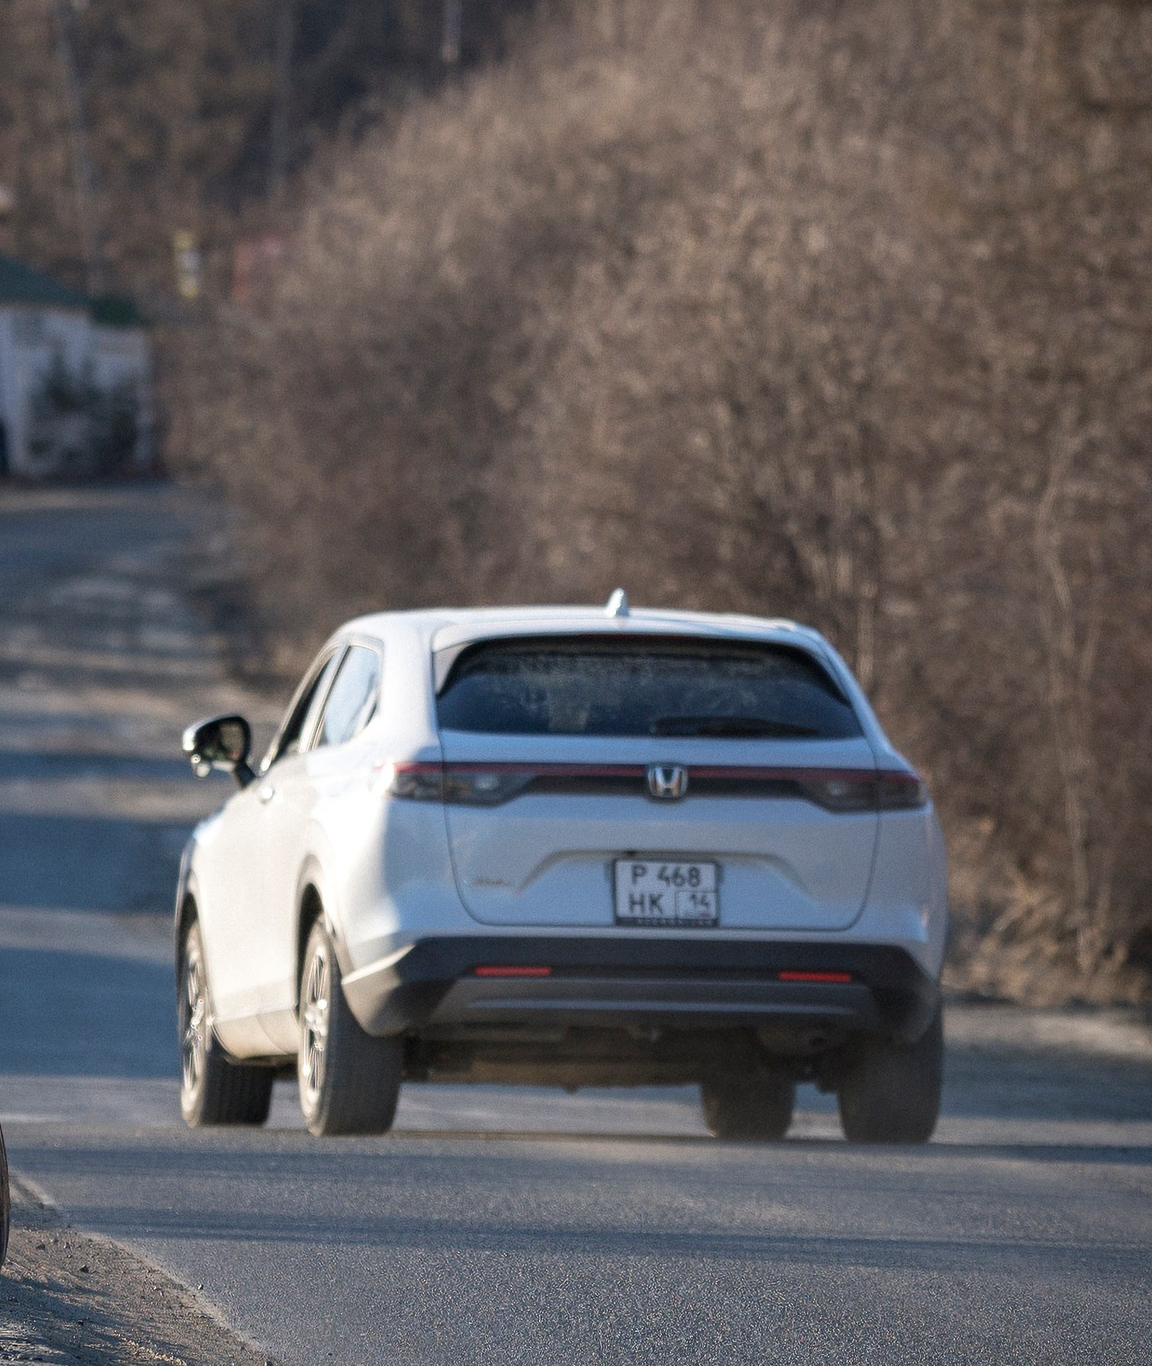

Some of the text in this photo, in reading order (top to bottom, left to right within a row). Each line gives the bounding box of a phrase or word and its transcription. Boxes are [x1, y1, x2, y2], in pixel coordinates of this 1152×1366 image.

[656, 865, 701, 887] 468
[629, 893, 710, 915] НК 14
